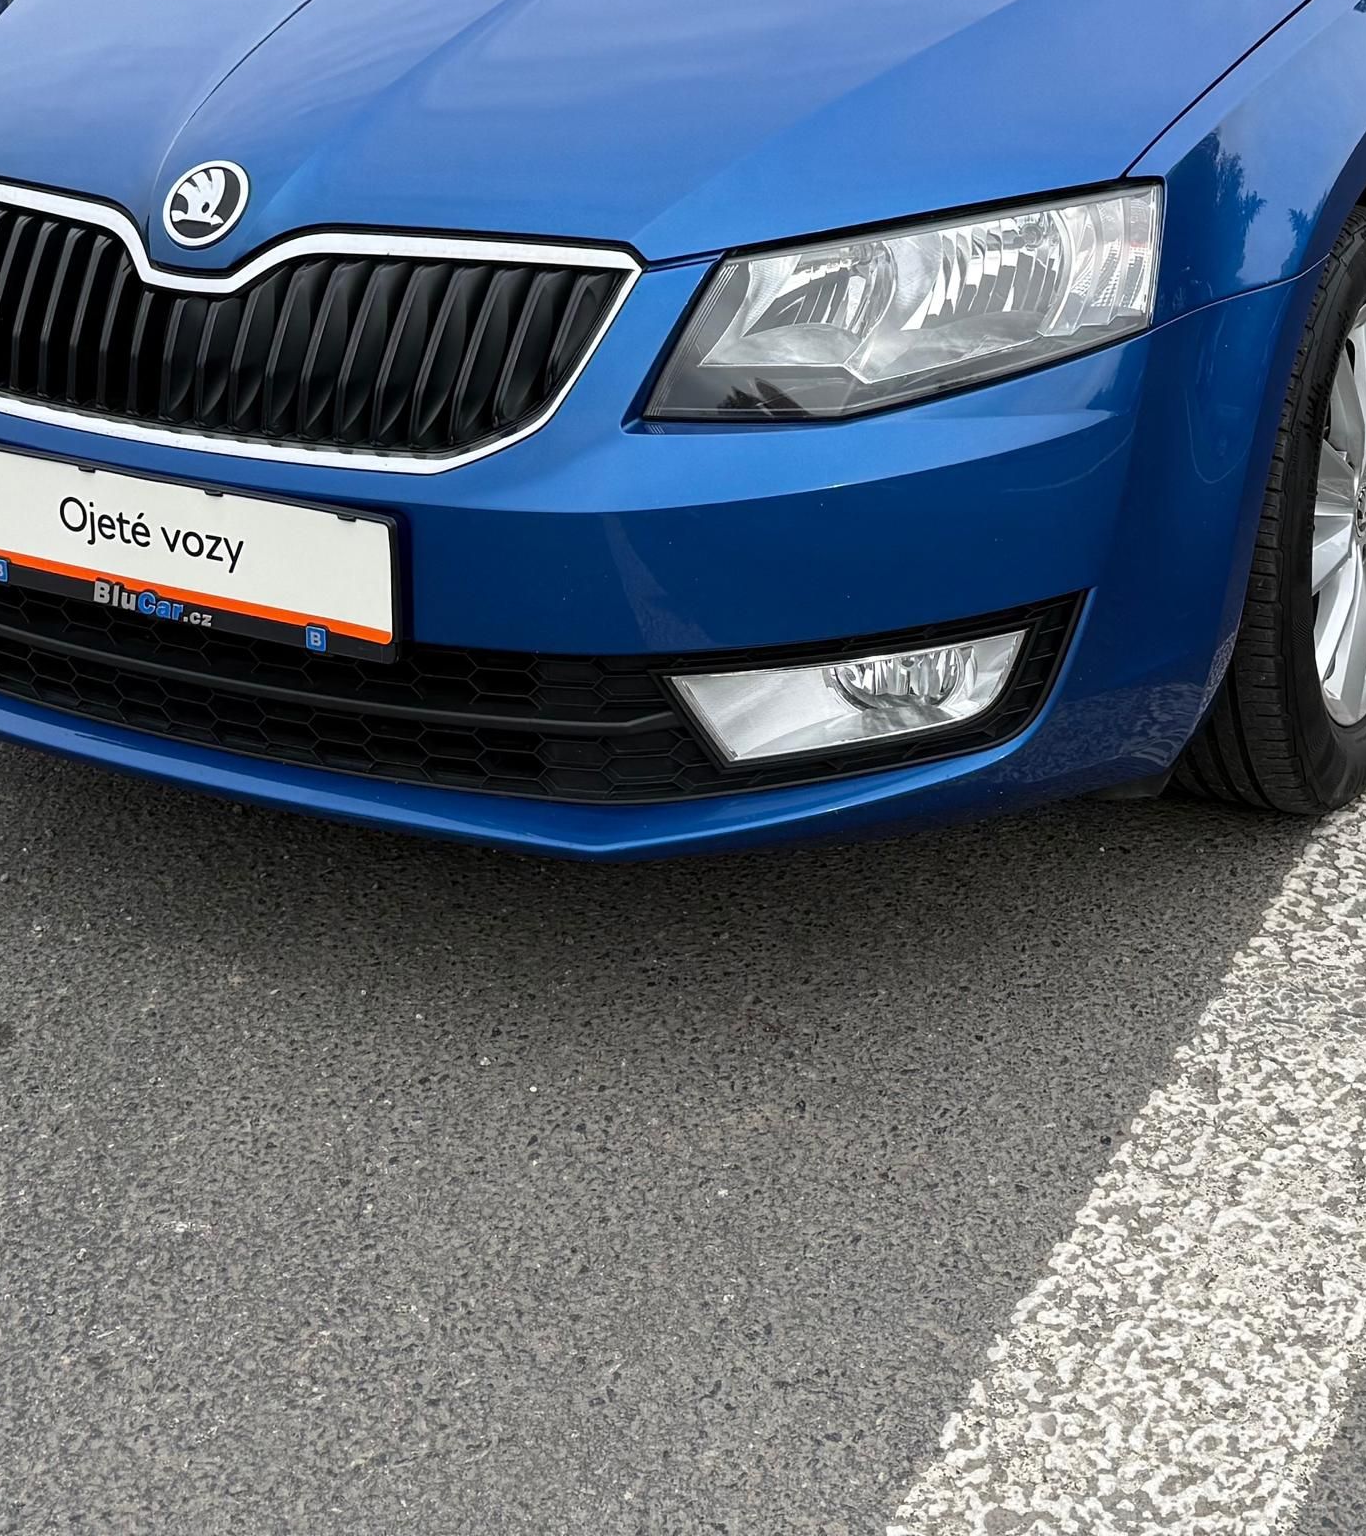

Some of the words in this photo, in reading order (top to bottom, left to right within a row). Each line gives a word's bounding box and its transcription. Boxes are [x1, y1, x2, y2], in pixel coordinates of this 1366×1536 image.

[59, 496, 151, 547] Ojeté
[160, 526, 244, 574] vozy
[93, 580, 212, 627] BluCar.cz
[310, 630, 322, 647] B
